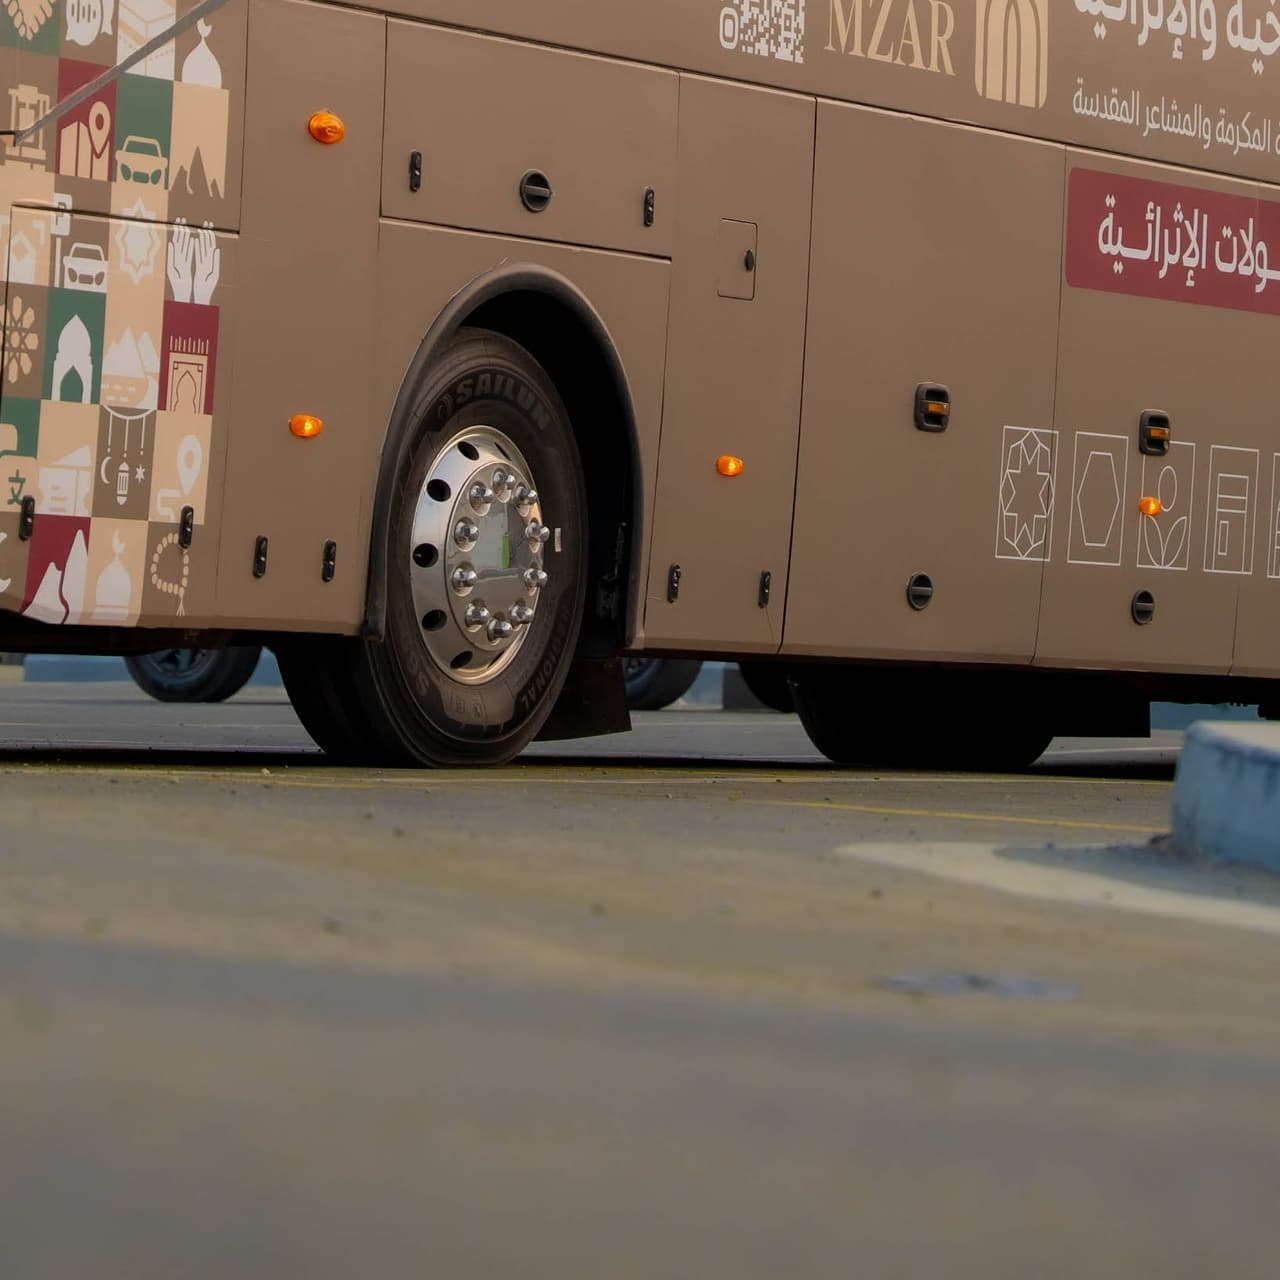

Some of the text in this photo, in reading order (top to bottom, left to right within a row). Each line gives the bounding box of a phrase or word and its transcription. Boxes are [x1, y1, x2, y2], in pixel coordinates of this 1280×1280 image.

[1072, 76, 1140, 126] المقدسة
[1142, 95, 1211, 150] والمشاعر
[1215, 107, 1271, 156] المكرمة
[1097, 194, 1209, 287] الإثرائية
